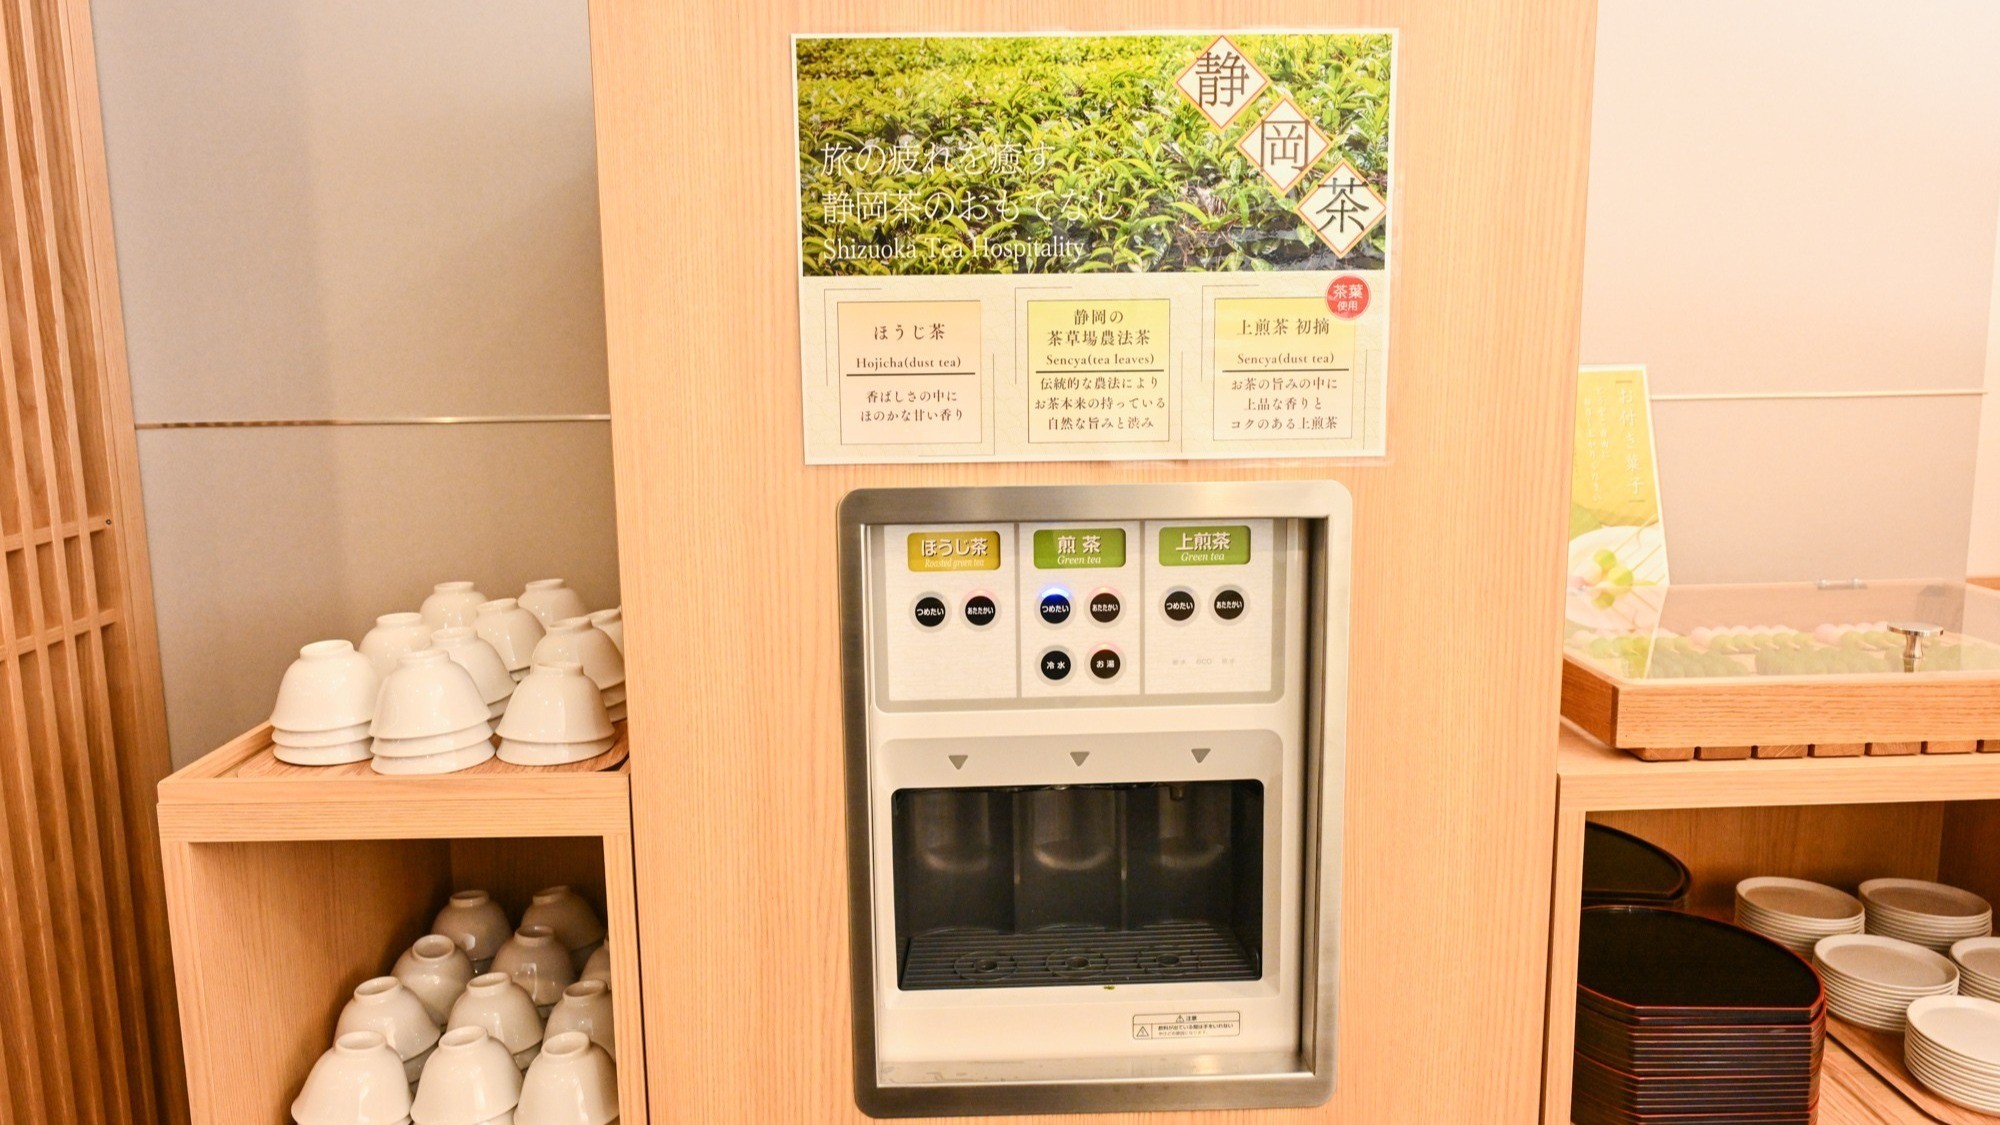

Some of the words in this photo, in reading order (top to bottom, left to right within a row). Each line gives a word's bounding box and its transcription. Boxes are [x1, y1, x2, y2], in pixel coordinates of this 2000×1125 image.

[1195, 51, 1250, 108] 静
[1260, 119, 1311, 172] 岡
[1315, 177, 1370, 233] 茶
[820, 141, 1056, 177] 旅の疲れを癒す
[822, 189, 1121, 225] 静岡茶のおもてなし
[824, 237, 918, 260] Shizuoka
[924, 237, 964, 259] Tea
[973, 235, 1085, 264] Hospitality
[1333, 283, 1364, 299] 茶葉
[1337, 301, 1358, 312] 使用
[1074, 309, 1124, 326] 静岡の
[874, 323, 946, 341] ほうじ茶
[1236, 318, 1289, 336] 上煎茶
[1296, 318, 1330, 336] 初摘
[1047, 330, 1151, 347] 茶草場農法茶
[856, 357, 935, 371] Hojicha(dust
[939, 357, 961, 368] tea)
[1046, 354, 1110, 368] Sencya(tea
[1114, 353, 1155, 365] leaves)
[1237, 353, 1308, 367] Sencya(dust
[1312, 353, 1335, 364] tea)
[1040, 376, 1159, 390] 伝統的な農法により
[1231, 377, 1338, 391] お茶の旨みの中に
[866, 390, 958, 403] 香ばしさの中に
[1034, 397, 1166, 410] お茶本来の持っている
[1244, 397, 1323, 411] 上品な香りと
[861, 409, 963, 422] ほのかな甘い香り
[1048, 417, 1154, 430] 自然な旨みと渋み
[1231, 416, 1338, 430] コクのある上煎茶
[921, 538, 989, 557] ほうじ茶
[1057, 535, 1102, 554] 煎茶
[1176, 532, 1231, 551] 上煎茶
[1057, 555, 1085, 565] Green
[1086, 555, 1101, 564] tea
[1180, 552, 1208, 562] Green
[1210, 552, 1225, 561] tea
[917, 608, 944, 616] つめたい
[967, 607, 994, 615] あたたかい
[1042, 605, 1069, 613] つめたい
[1092, 604, 1119, 612] あたたかい
[1166, 602, 1194, 610] つめたい
[1216, 601, 1242, 609] あたたかい
[1046, 661, 1066, 670] 冷水
